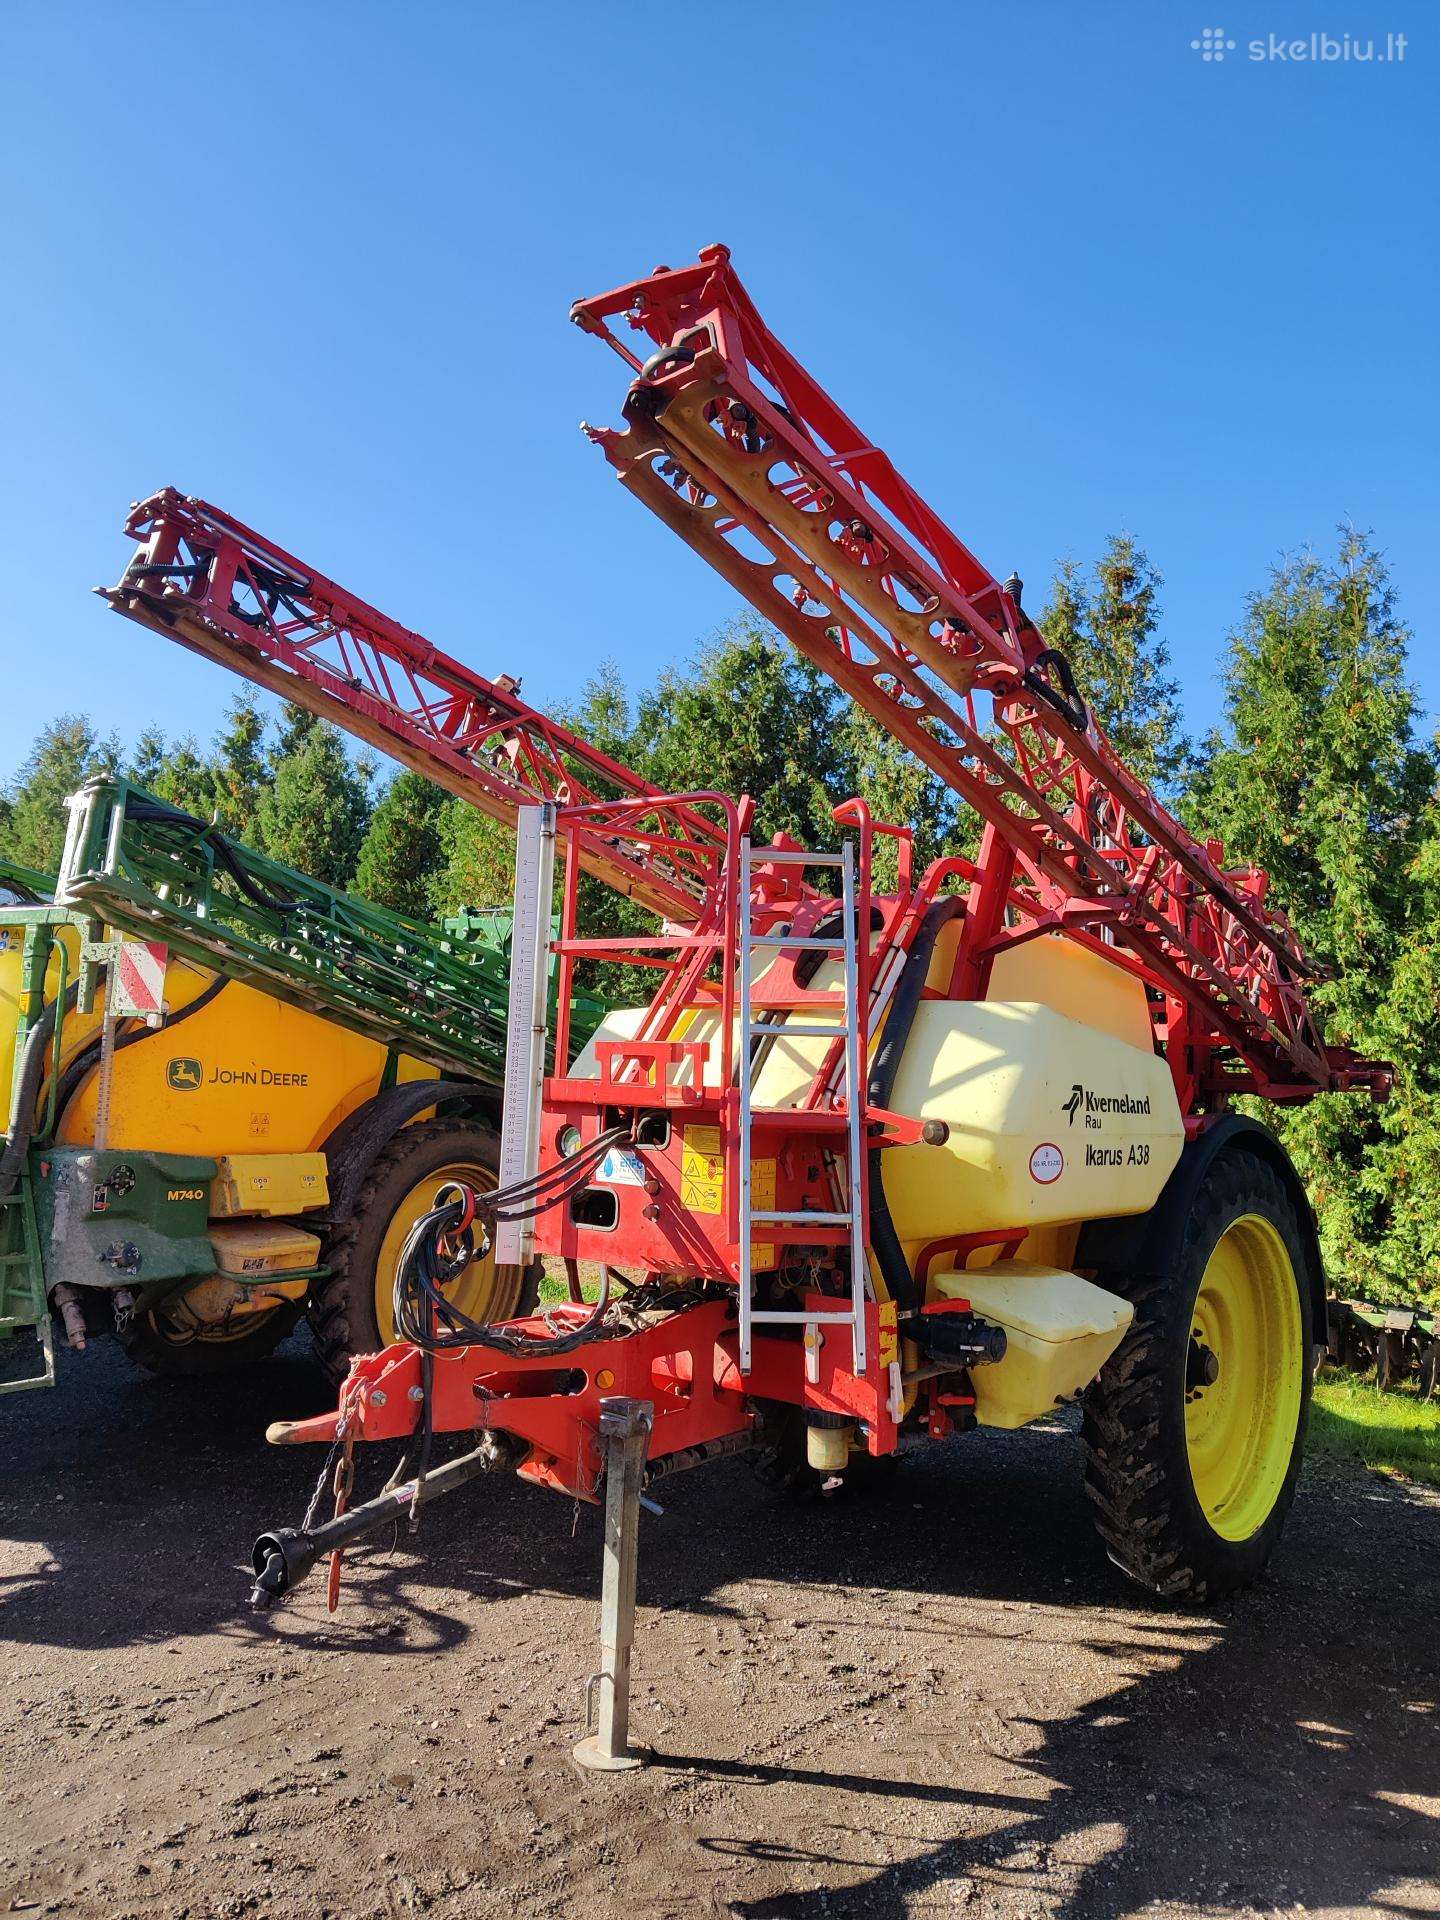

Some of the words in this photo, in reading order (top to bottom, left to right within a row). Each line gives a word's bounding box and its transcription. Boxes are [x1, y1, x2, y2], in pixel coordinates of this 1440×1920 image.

[208, 1067, 257, 1085] JOHN
[261, 1069, 308, 1087] DEERE
[1085, 1091, 1151, 1115] Kverneland
[1085, 1114, 1102, 1129] Rau
[1085, 1144, 1123, 1166] Ikarus
[1127, 1144, 1150, 1166] A38
[167, 1190, 204, 1201] M740
